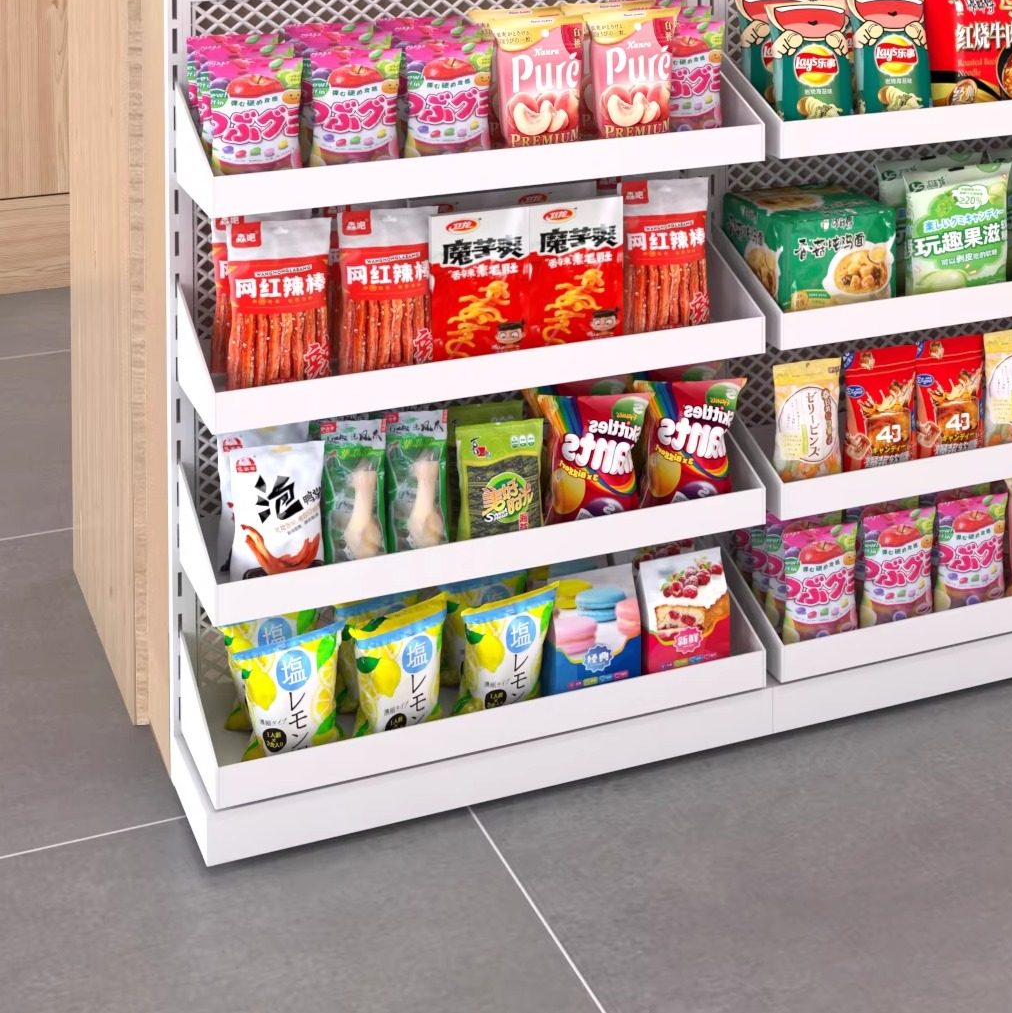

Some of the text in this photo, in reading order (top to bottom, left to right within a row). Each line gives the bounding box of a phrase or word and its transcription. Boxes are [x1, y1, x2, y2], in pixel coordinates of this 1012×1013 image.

[512, 52, 580, 93] Puré
[606, 46, 671, 85] Puré
[442, 235, 524, 268] 魔芋爽
[540, 224, 618, 254] 魔芋爽
[627, 227, 705, 252] 网红辣棒
[914, 223, 1001, 258] 玩趣果滋
[235, 272, 326, 299] 网红辣棒
[255, 475, 303, 524] 泡
[510, 623, 534, 649] 塩
[406, 641, 429, 666] 塩
[280, 656, 308, 684] 塩
